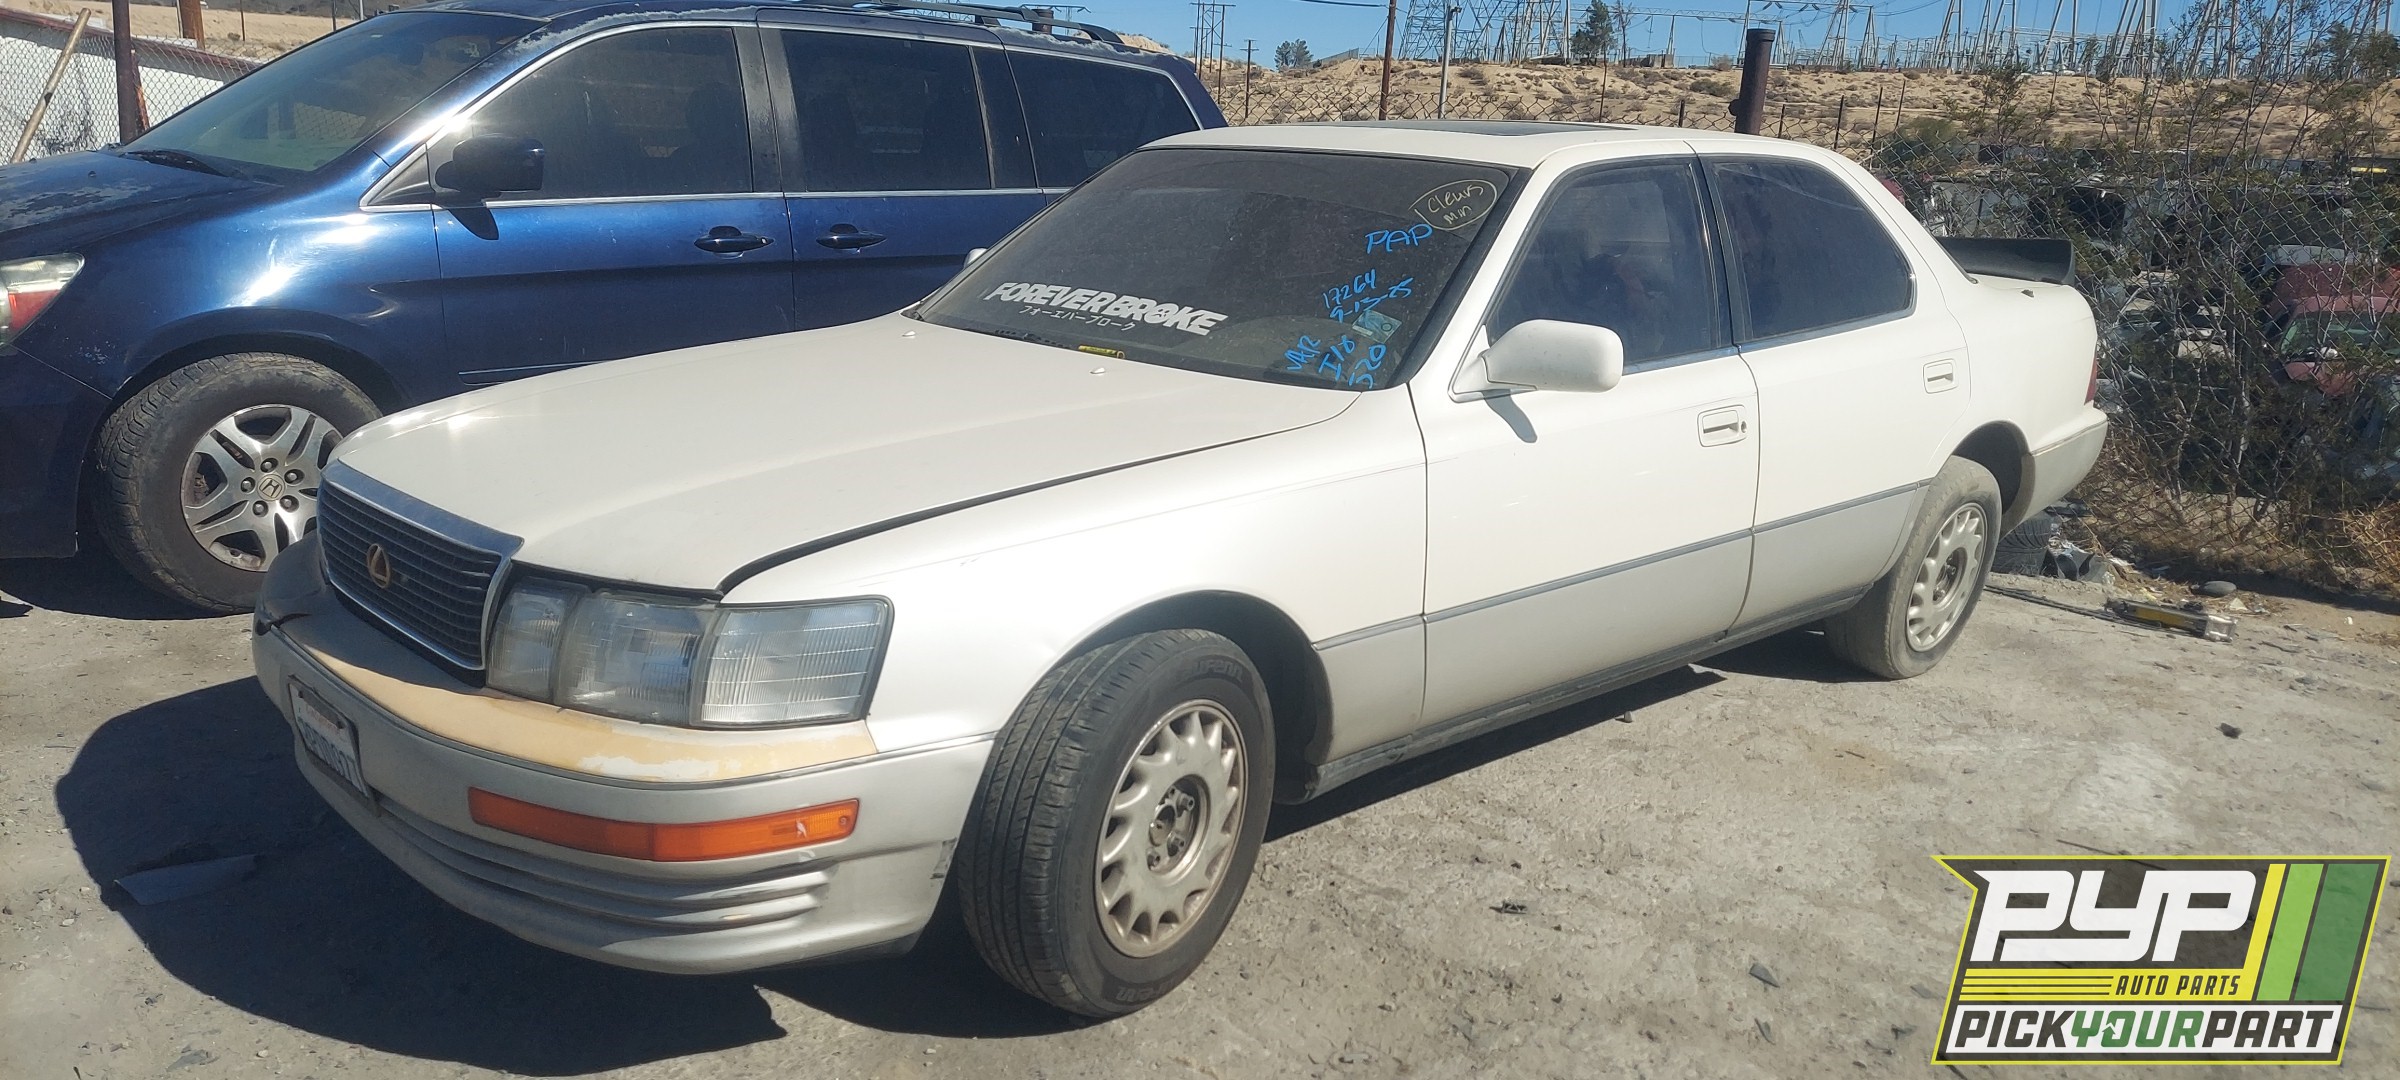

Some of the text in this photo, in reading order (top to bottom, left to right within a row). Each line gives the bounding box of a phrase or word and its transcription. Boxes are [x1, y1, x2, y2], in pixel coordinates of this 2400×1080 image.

[1364, 223, 1433, 254] PAP
[1323, 269, 1377, 309] 17264
[983, 282, 1229, 337] FOREVER BROKE
